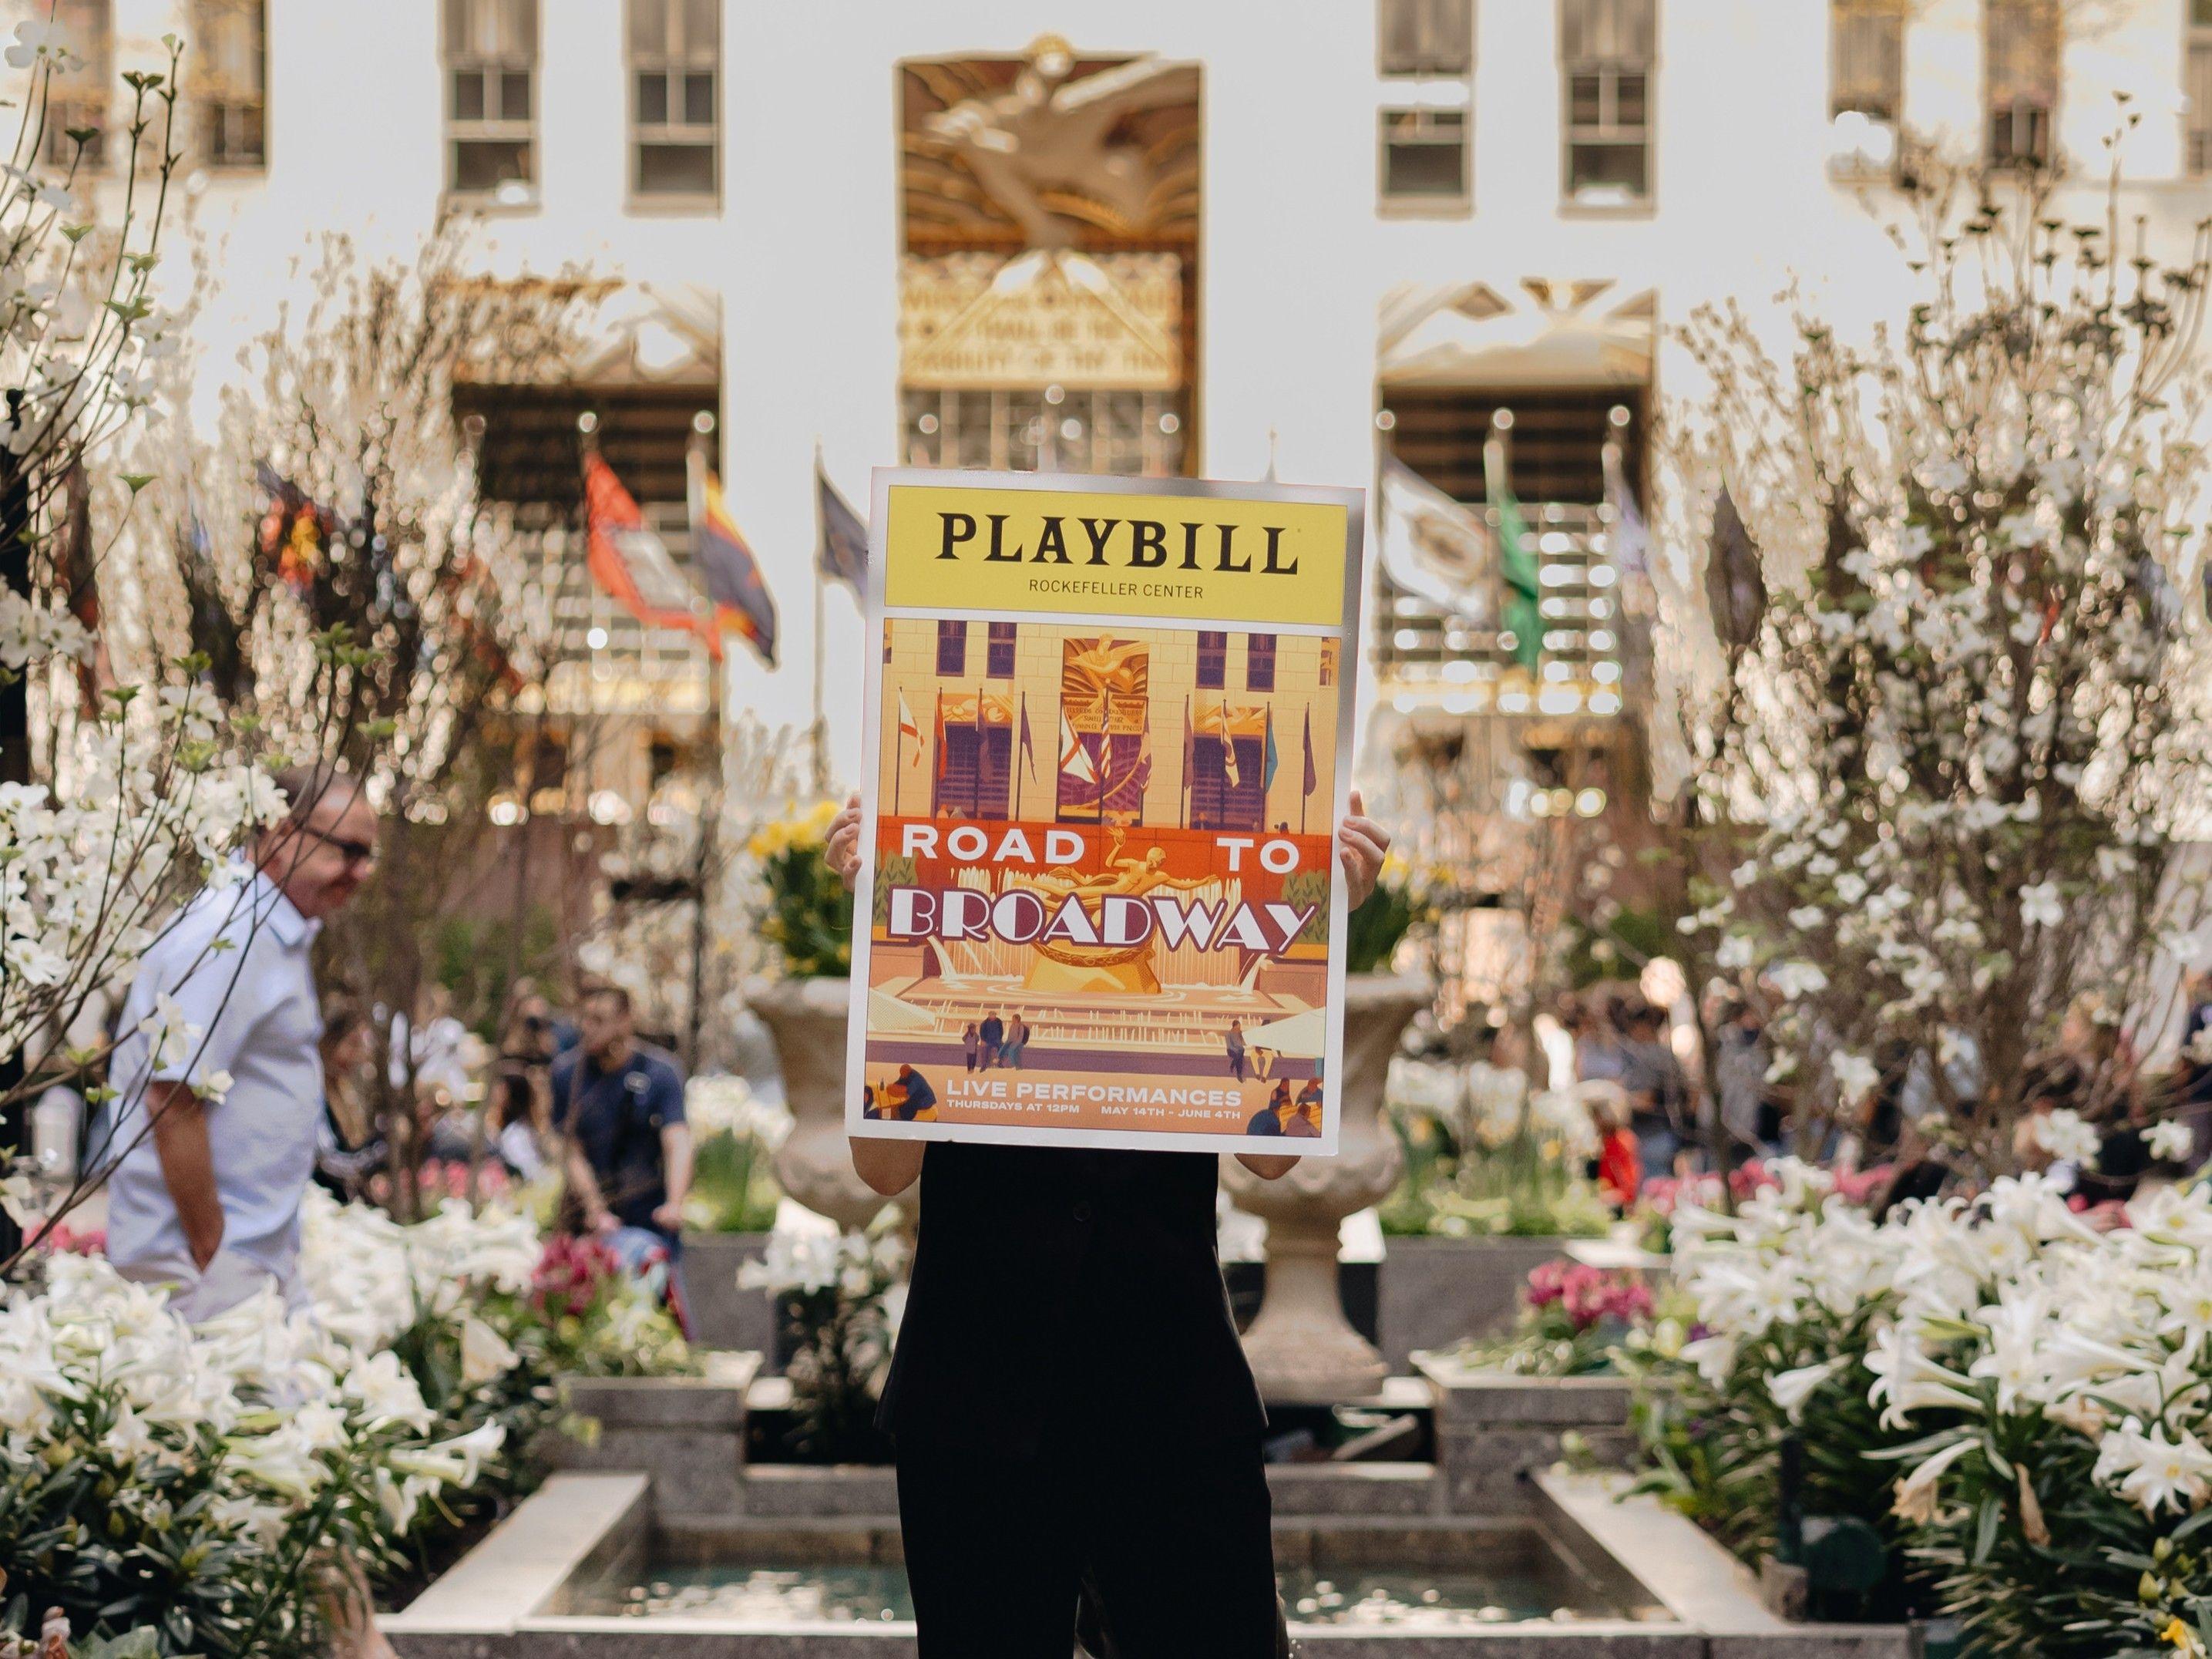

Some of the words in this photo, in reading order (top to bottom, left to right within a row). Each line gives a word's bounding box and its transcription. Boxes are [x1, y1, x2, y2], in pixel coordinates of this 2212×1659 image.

[935, 512, 1299, 575] PLAYBILL
[1029, 579, 1138, 596] ROCKEFELLER
[1143, 584, 1204, 599] CENTER
[901, 824, 1085, 865] ROAD
[1216, 837, 1300, 874] TO
[888, 886, 1318, 954] BROADWAY
[946, 1079, 1007, 1098] LIVE
[1016, 1082, 1242, 1107] PERFORMANCES
[946, 1099, 1024, 1111] THURSDAYS
[1026, 1103, 1044, 1112] AT
[1047, 1104, 1081, 1114] 12PM
[1101, 1106, 1129, 1116] MAY
[1133, 1108, 1165, 1117] 14TH
[1178, 1109, 1211, 1119] JUNE
[1215, 1110, 1242, 1119] 4TH
